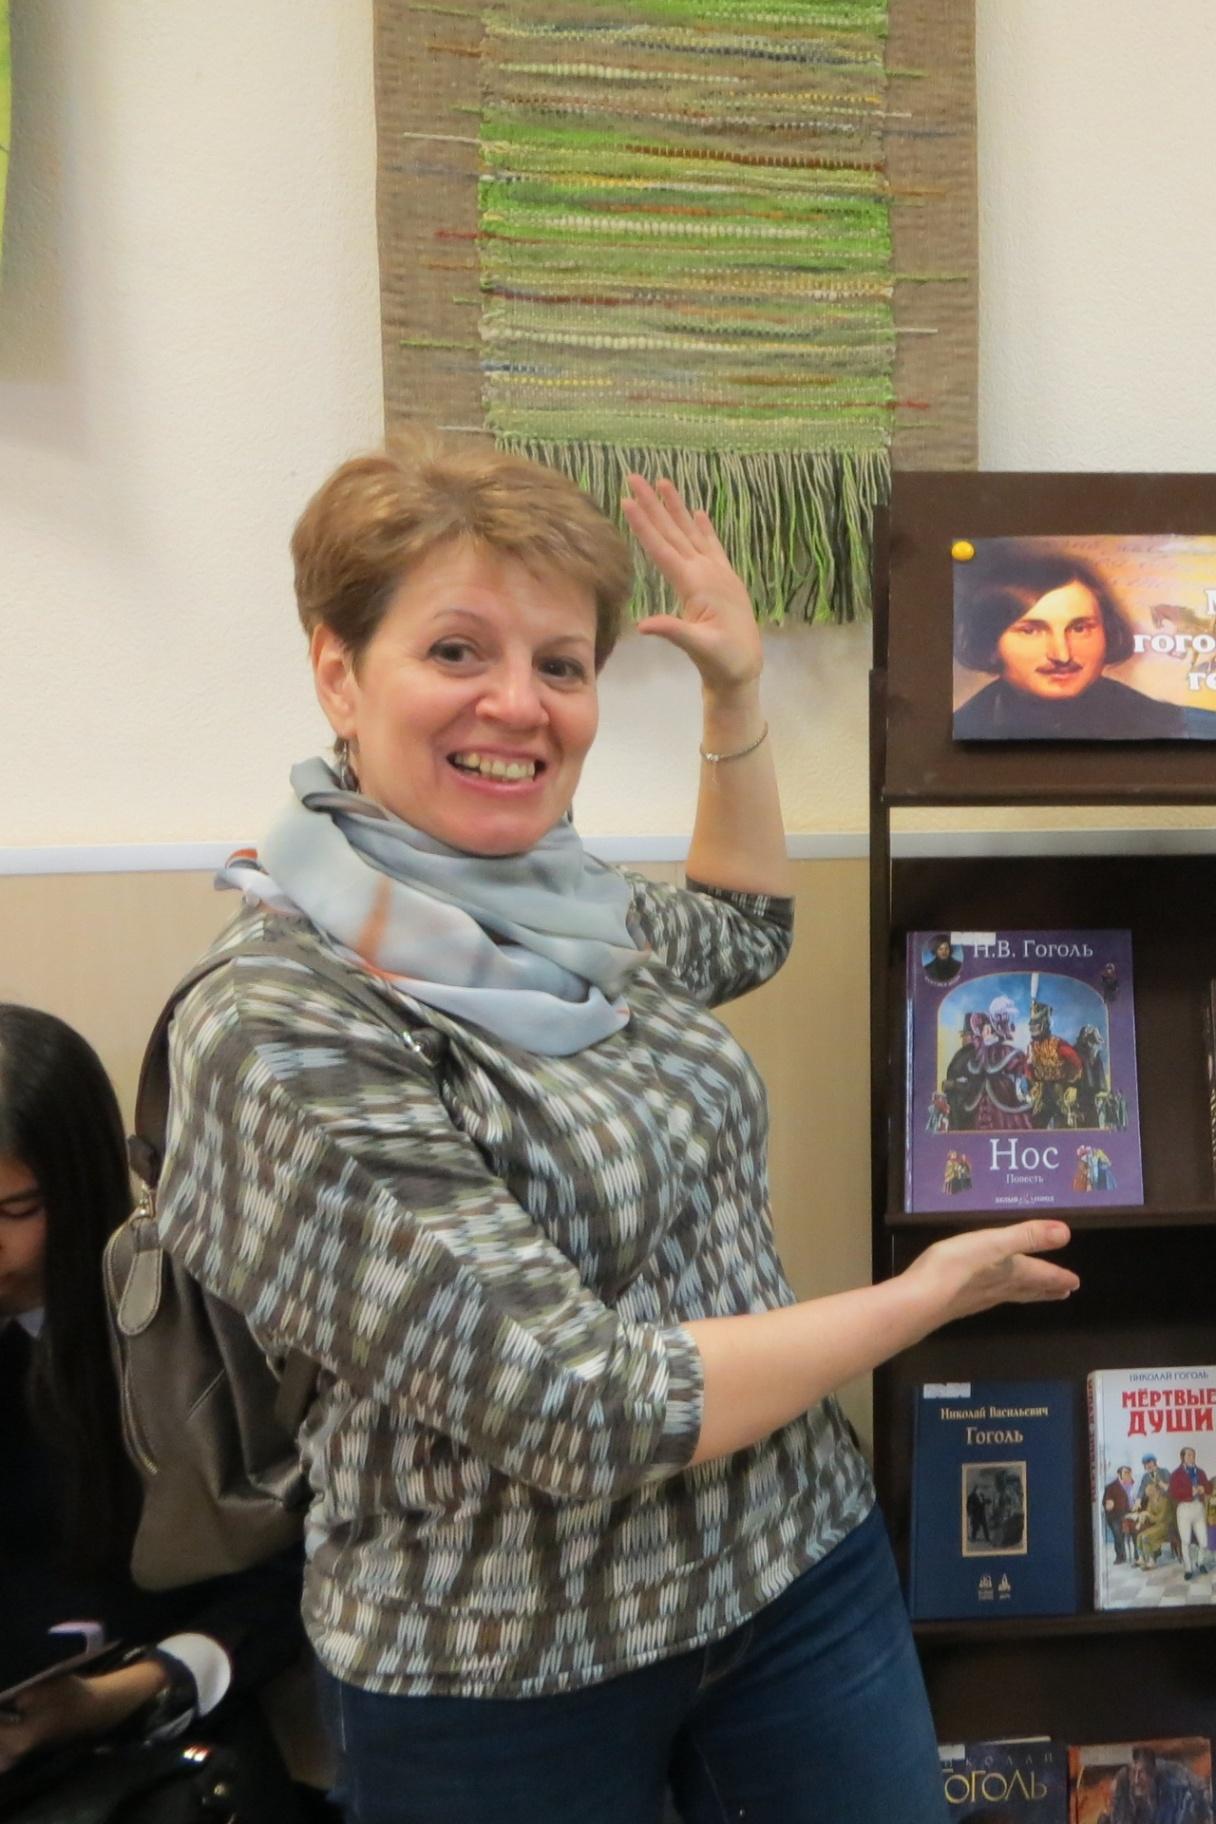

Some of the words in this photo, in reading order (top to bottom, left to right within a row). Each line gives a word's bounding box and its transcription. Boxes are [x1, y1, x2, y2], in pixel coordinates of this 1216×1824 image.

[972, 941, 1016, 959] Н.В.
[1023, 939, 1093, 958] Гоголь
[989, 1138, 1060, 1170] Нос
[1174, 1371, 1209, 1381] ГОГОЛЬ
[940, 1406, 987, 1421] Николай
[988, 1405, 1050, 1420] Васильевич
[1127, 1408, 1214, 1436] ДУШИ
[965, 1425, 1025, 1446] Гоголь
[943, 1752, 1054, 1769] ИКОЛАЙ
